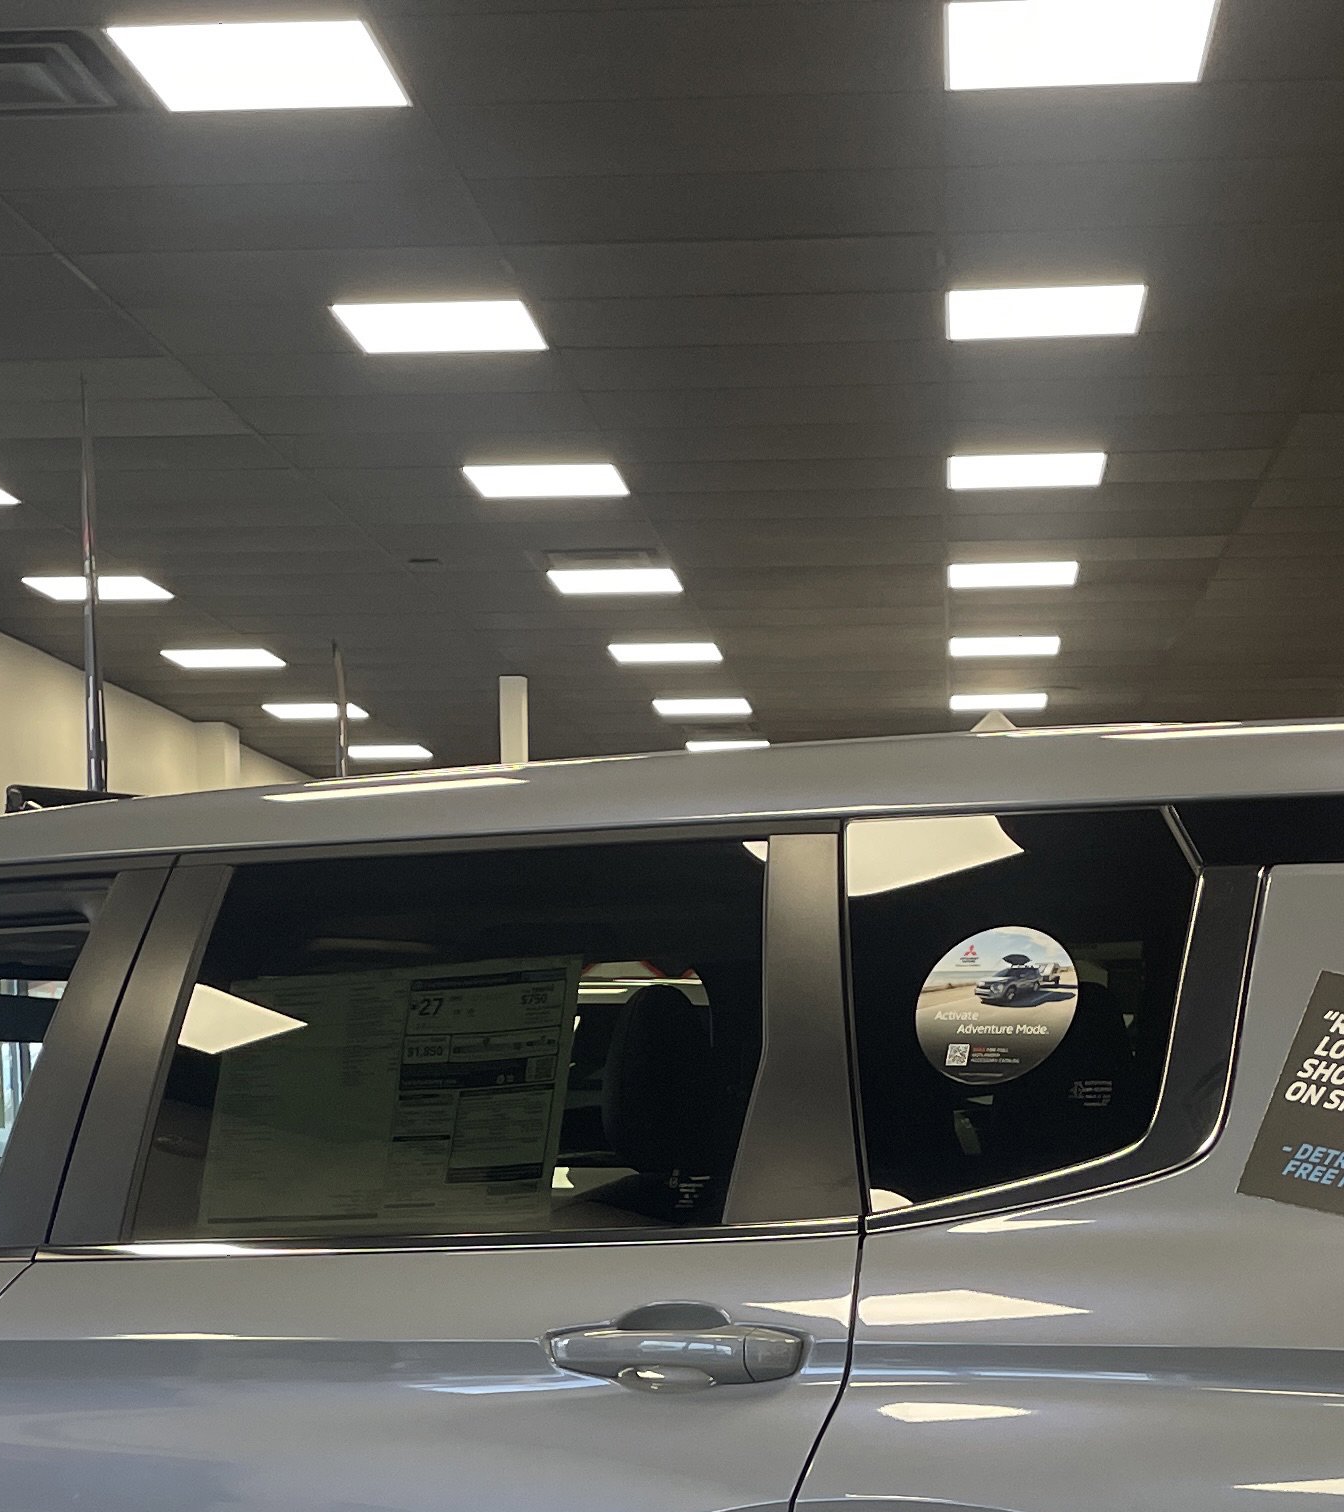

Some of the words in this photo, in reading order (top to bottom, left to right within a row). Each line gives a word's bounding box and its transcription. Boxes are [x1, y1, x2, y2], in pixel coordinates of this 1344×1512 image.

[418, 998, 444, 1016] 27
[934, 1010, 979, 1021] Activate
[957, 1024, 1014, 1035] Adventure
[1284, 1081, 1326, 1106] ON
[1282, 1160, 1339, 1185] FREE
